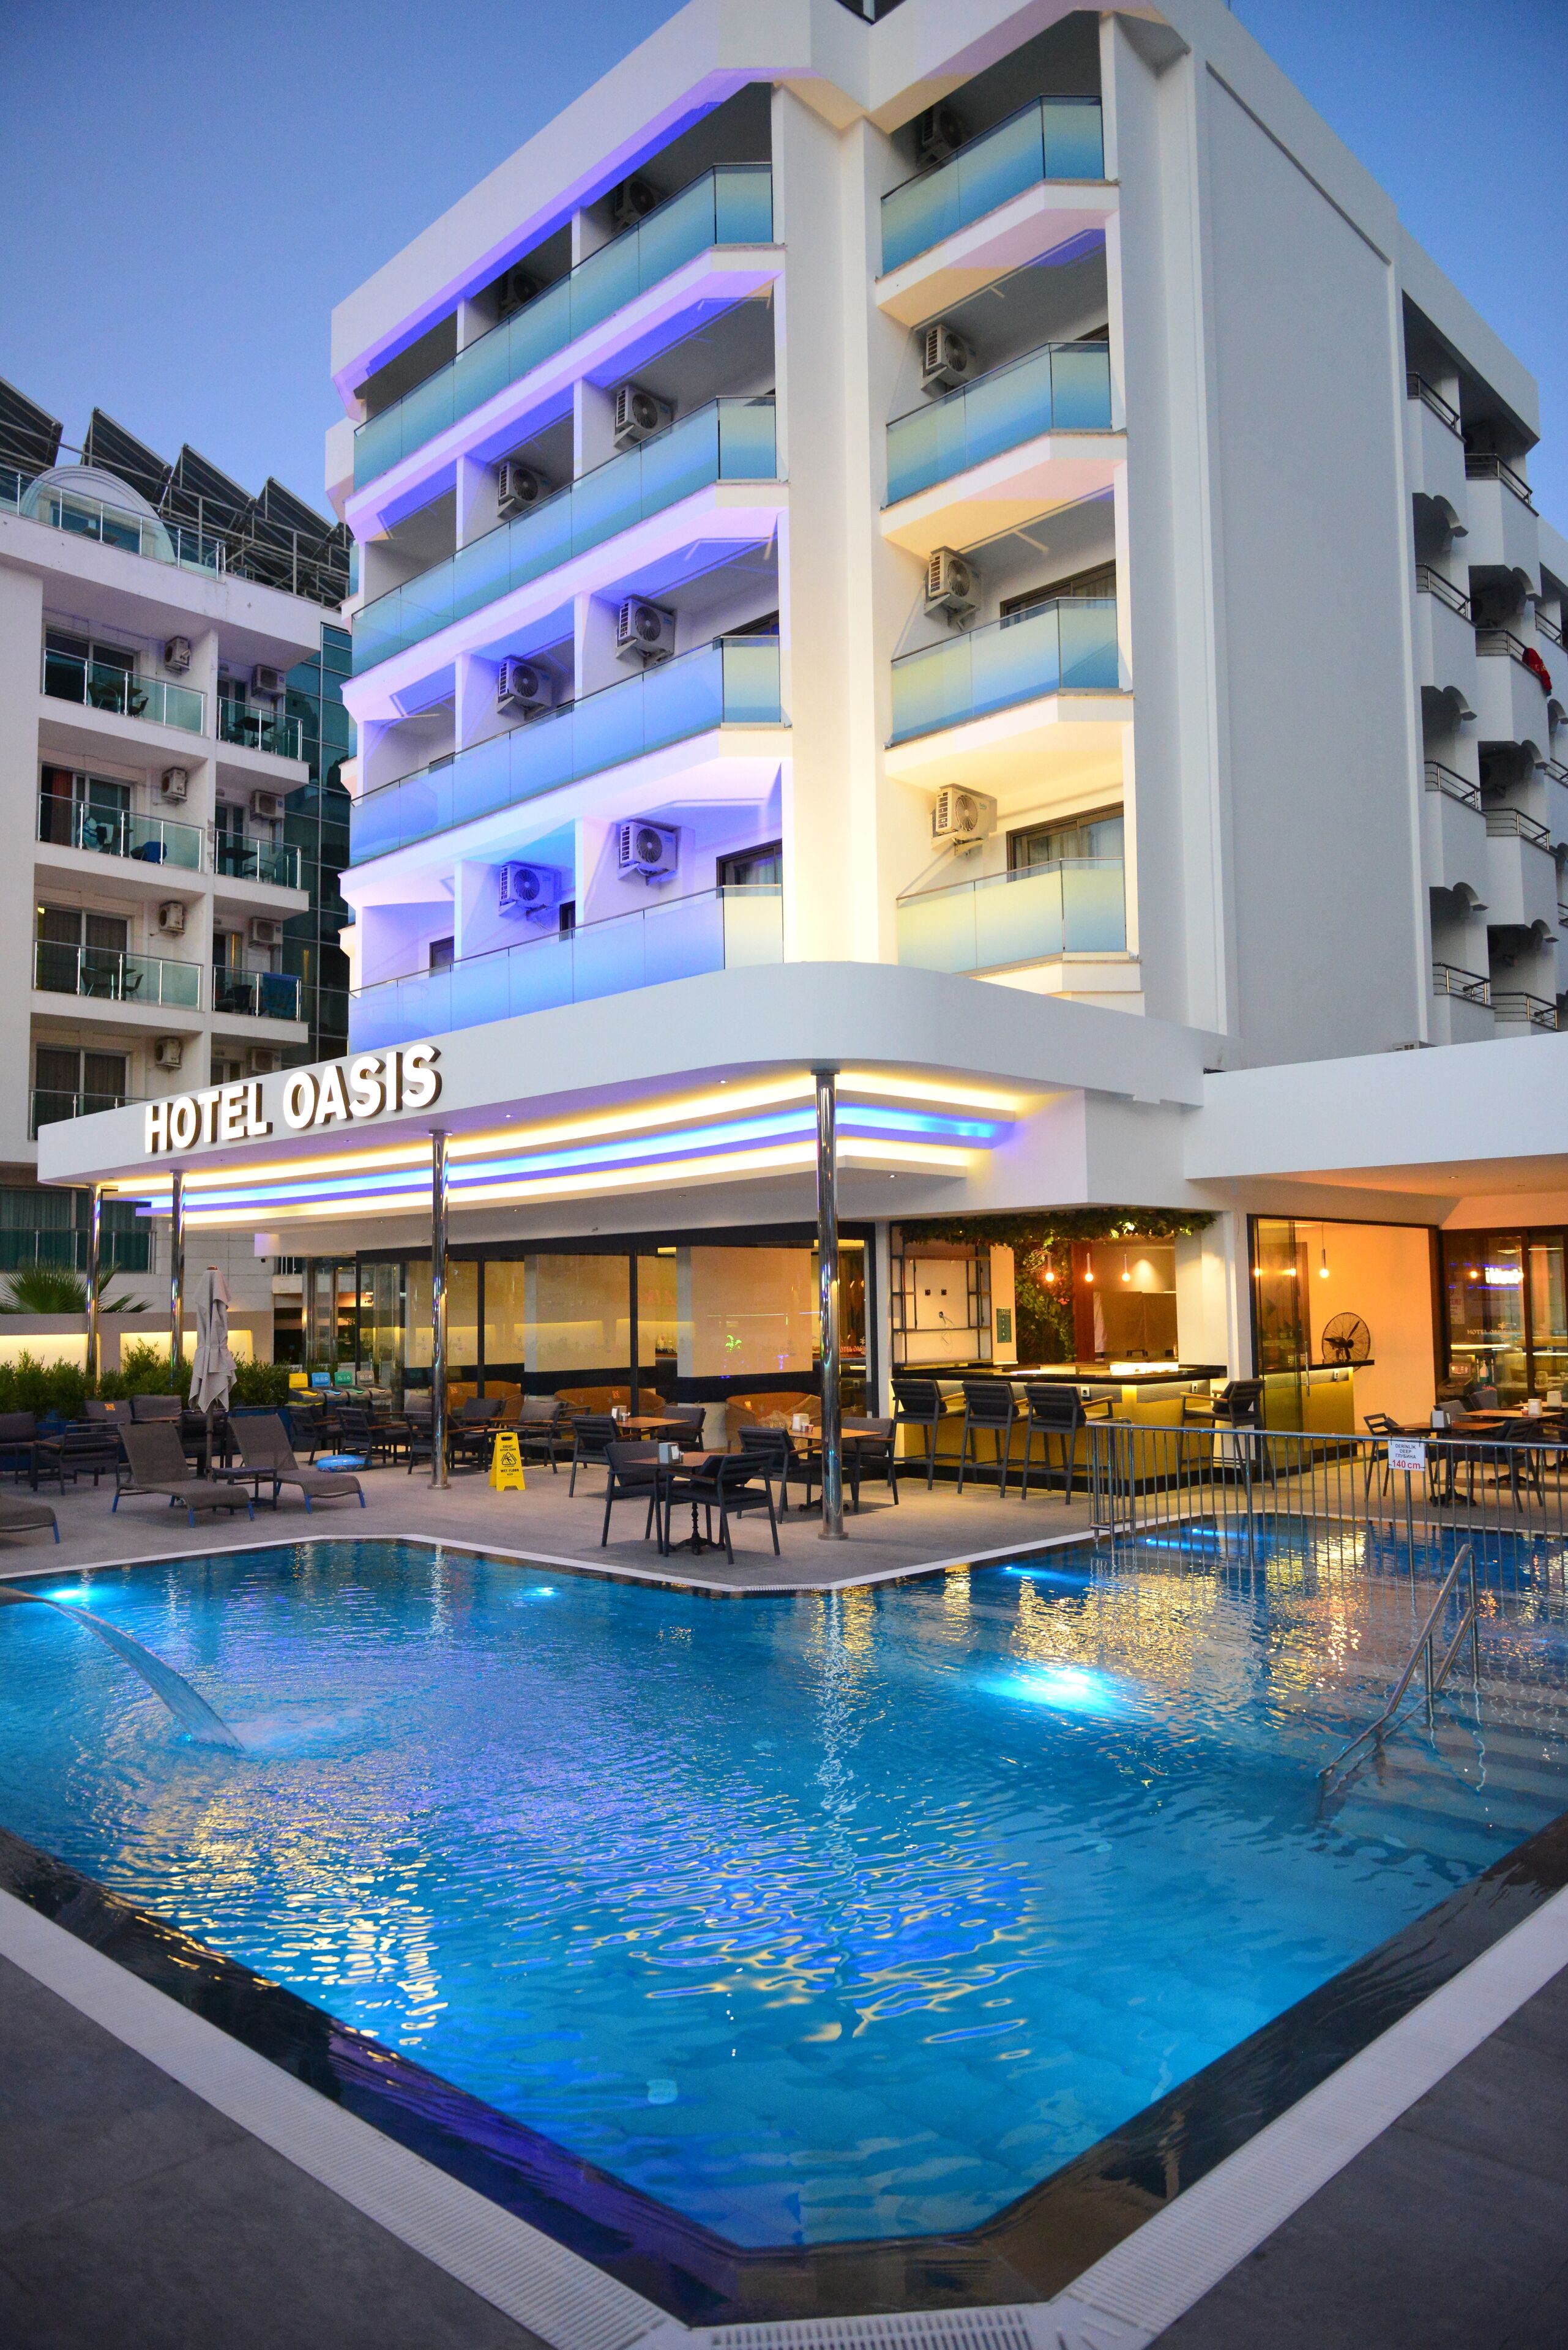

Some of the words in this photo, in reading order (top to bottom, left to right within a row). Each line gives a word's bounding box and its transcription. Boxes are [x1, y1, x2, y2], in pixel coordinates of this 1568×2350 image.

[145, 1083, 272, 1154] HOTEL
[283, 1044, 442, 1130] OASIS
[1392, 1460, 1406, 1468] 140
